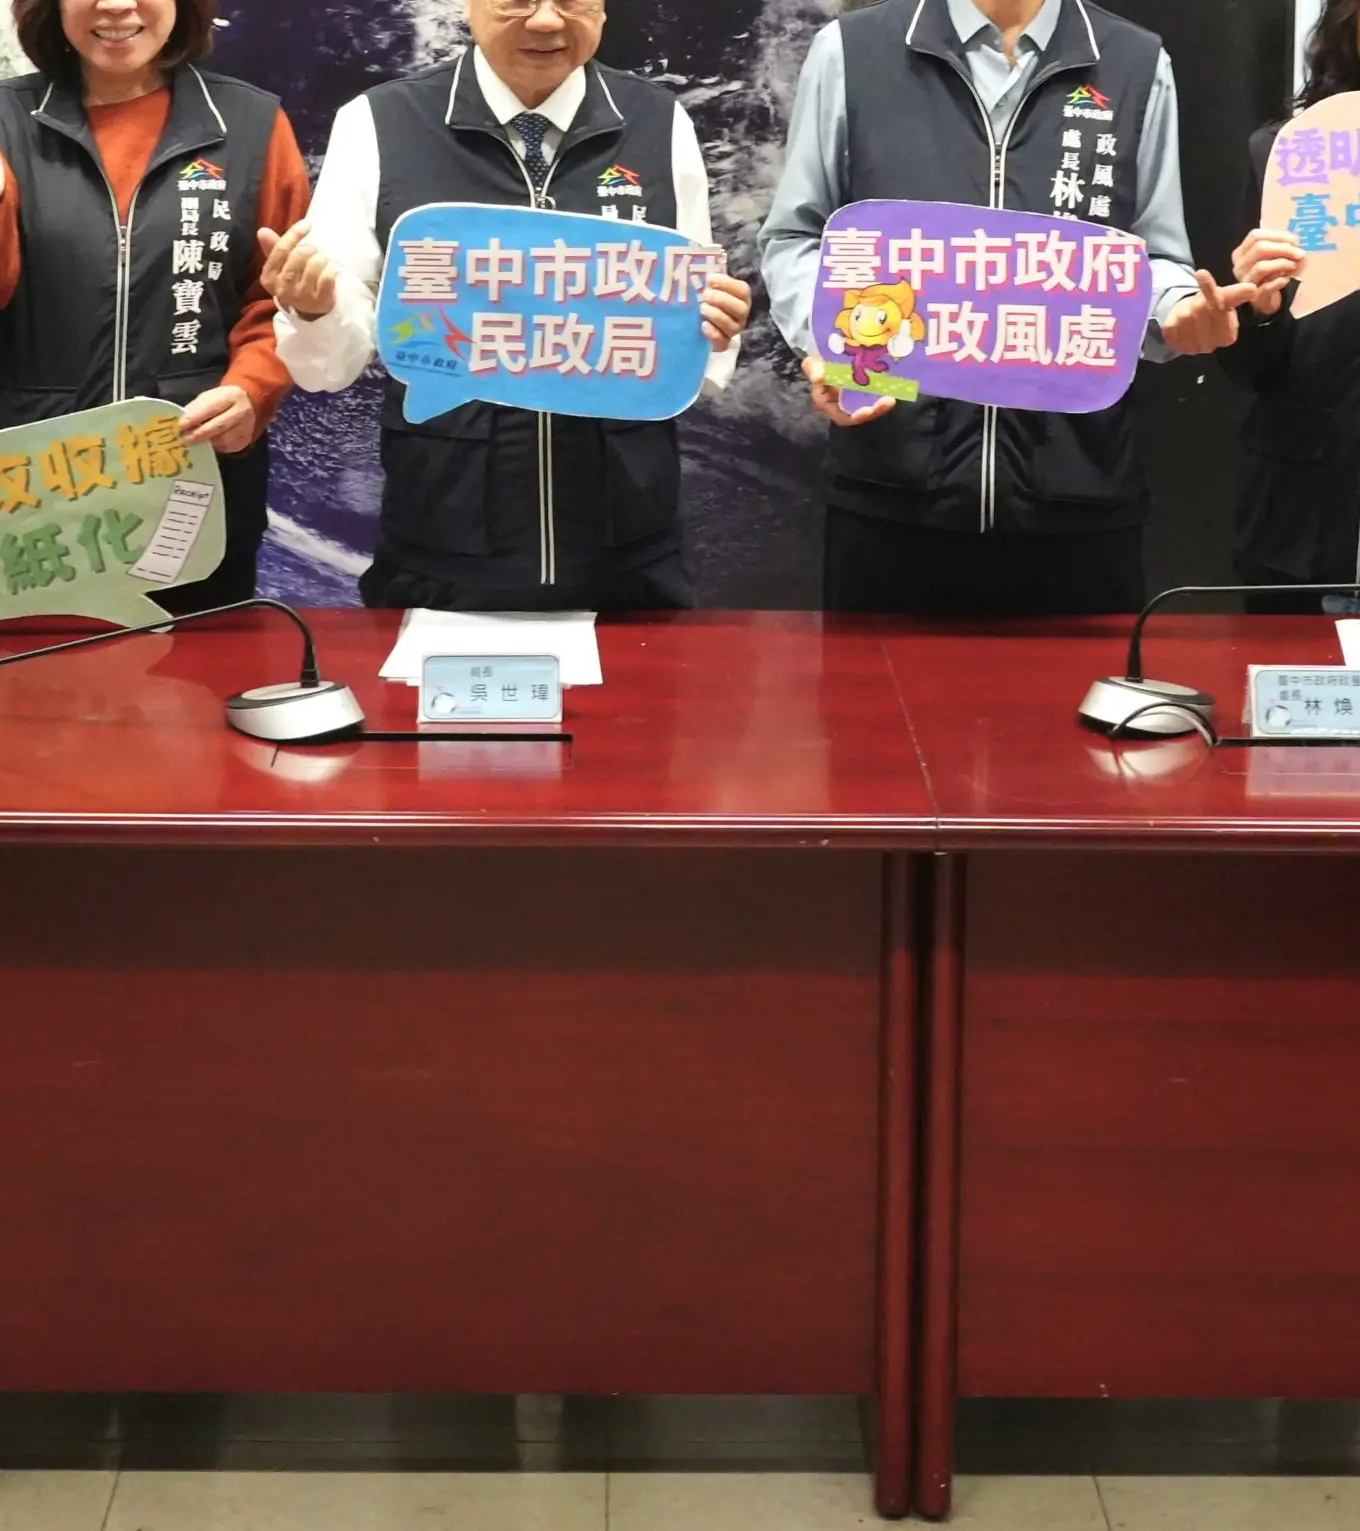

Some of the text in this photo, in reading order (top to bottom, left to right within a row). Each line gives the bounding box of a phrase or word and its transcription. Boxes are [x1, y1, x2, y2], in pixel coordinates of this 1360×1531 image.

[1088, 133, 1117, 217] 政風處
[207, 198, 231, 281] 民政局
[397, 237, 727, 304] 臺中市政府
[822, 227, 1145, 294] 臺中市政府
[171, 239, 205, 354] 陳寶雲
[467, 312, 658, 379] 民政局
[924, 301, 1117, 367] 政風處
